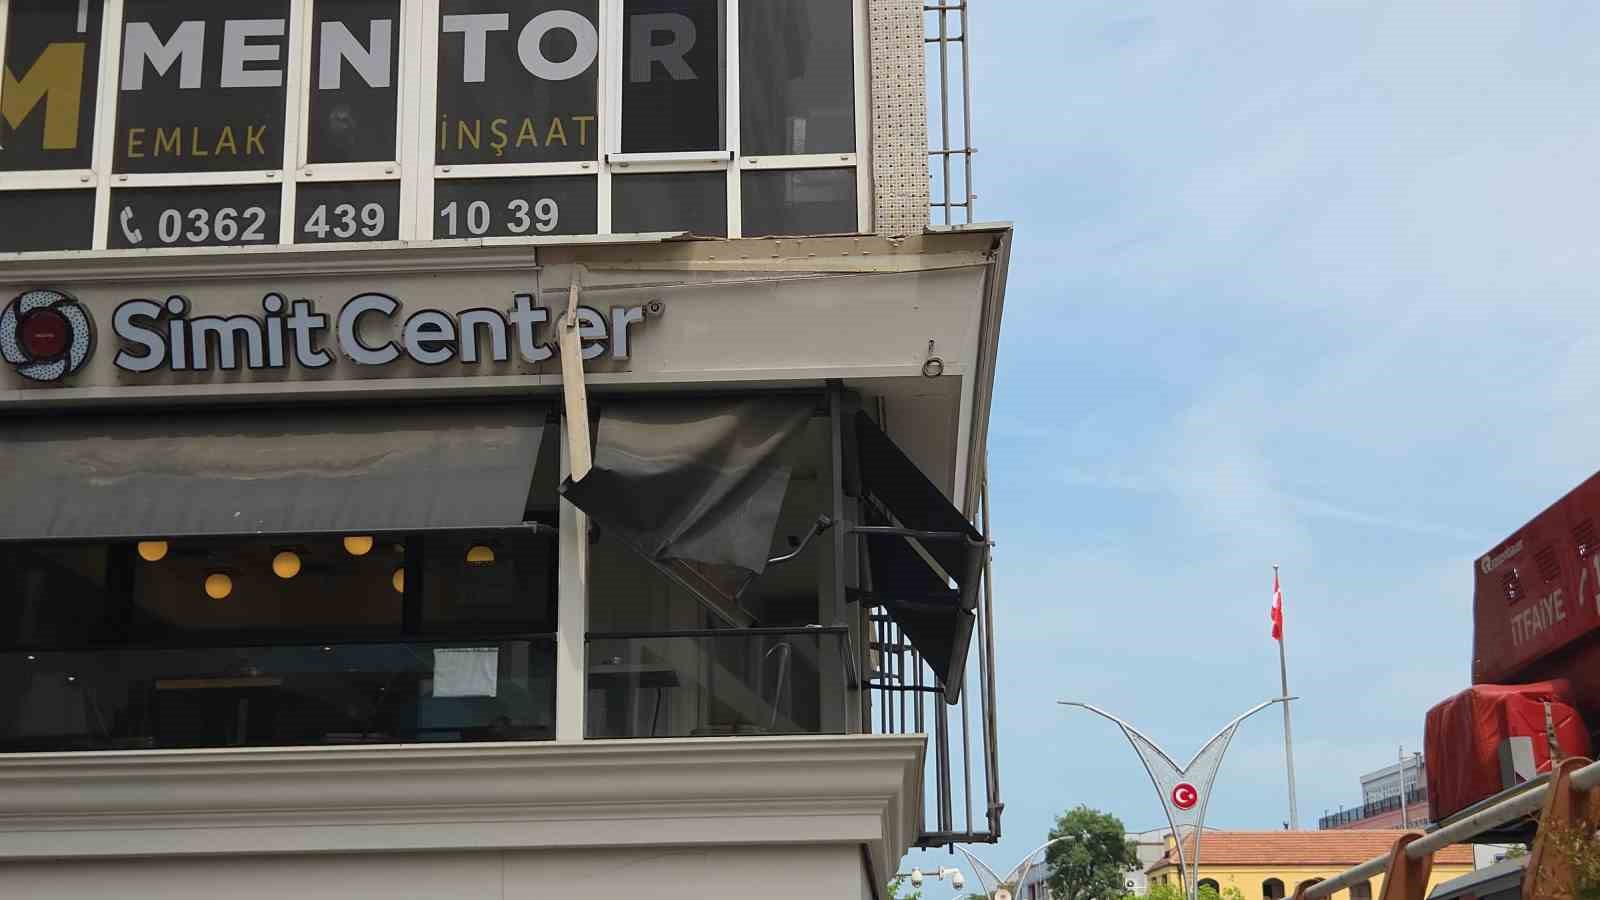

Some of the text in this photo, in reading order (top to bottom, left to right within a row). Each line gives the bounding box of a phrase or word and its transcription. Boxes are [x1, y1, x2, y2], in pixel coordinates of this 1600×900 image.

[120, 10, 699, 91] MENTOR
[127, 113, 595, 158] EMLAK İNŞAAT
[158, 198, 559, 243] 0362 439 10 39
